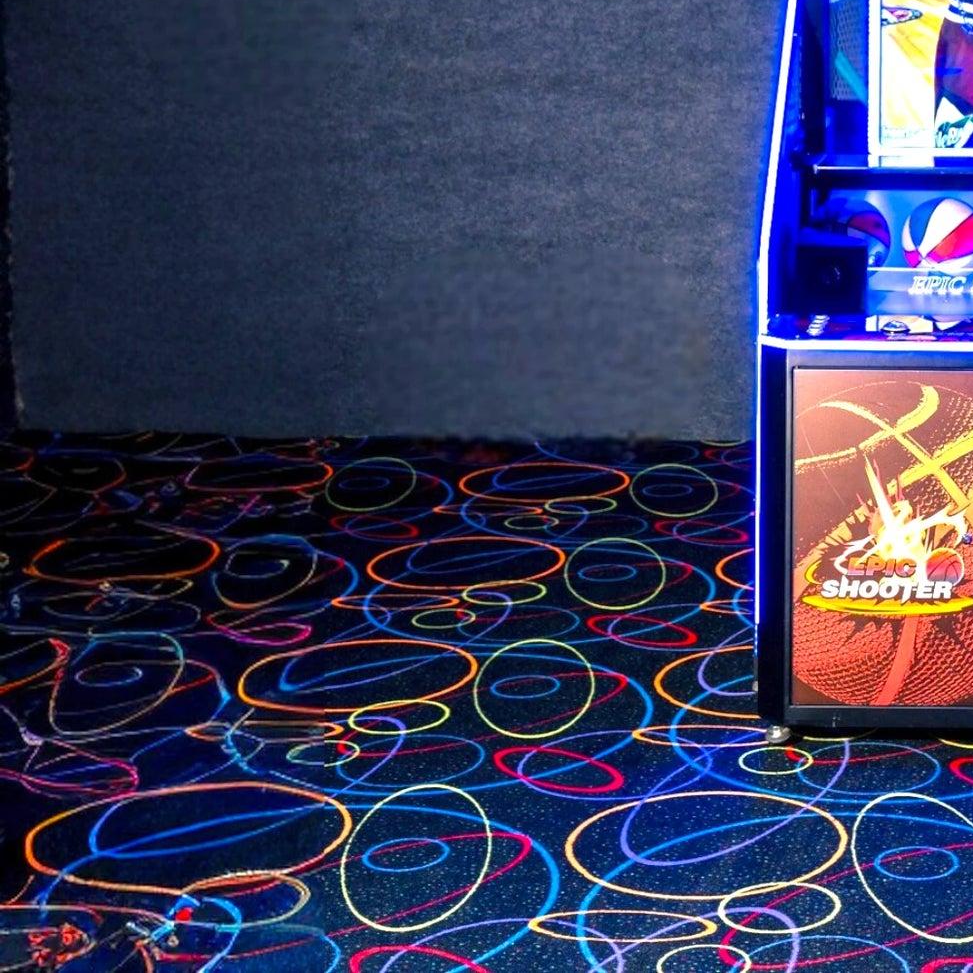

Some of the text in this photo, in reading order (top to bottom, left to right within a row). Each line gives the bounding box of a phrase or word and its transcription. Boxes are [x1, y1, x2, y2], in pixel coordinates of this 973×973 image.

[908, 276, 966, 295] EPIC
[846, 556, 917, 577] EPIC
[820, 576, 953, 603] SHOOTER
